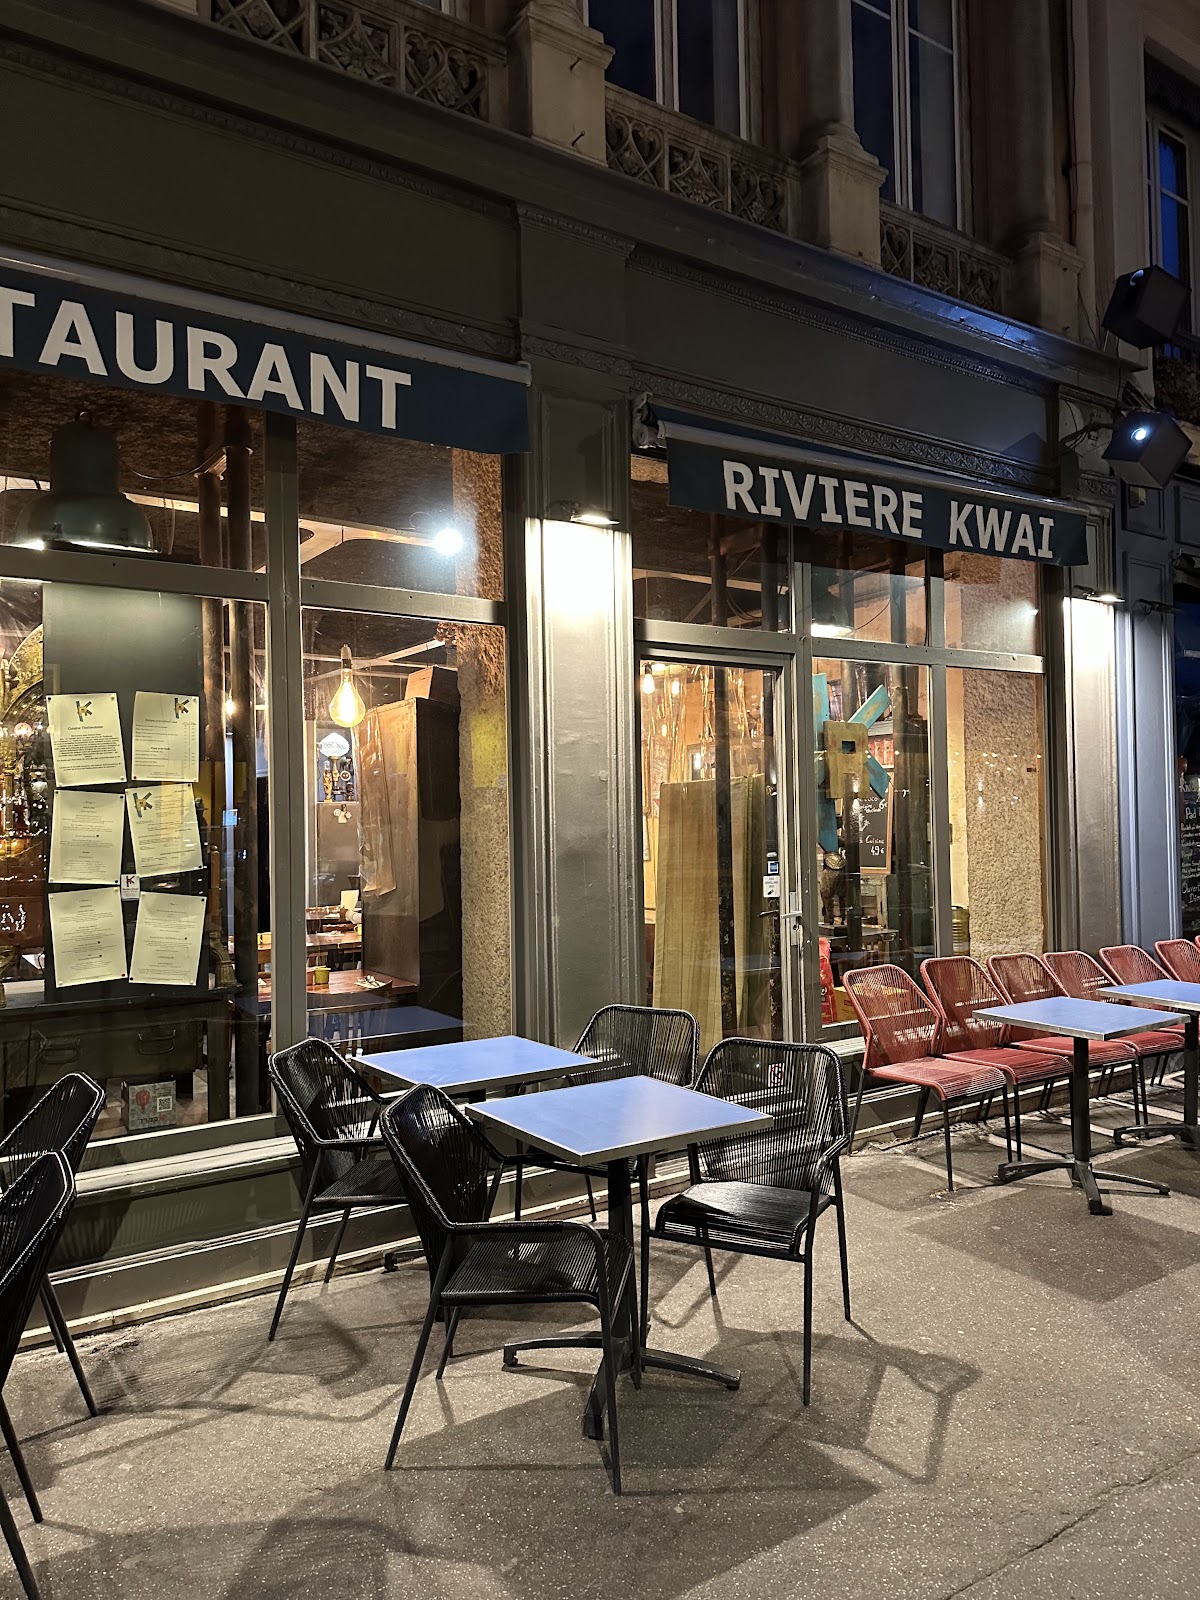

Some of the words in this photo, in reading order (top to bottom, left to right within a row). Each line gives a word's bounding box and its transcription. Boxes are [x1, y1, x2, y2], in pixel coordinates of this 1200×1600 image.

[0, 286, 412, 430] TAURANT
[722, 459, 923, 539] RIVIERE
[949, 500, 1055, 559] KWAI
